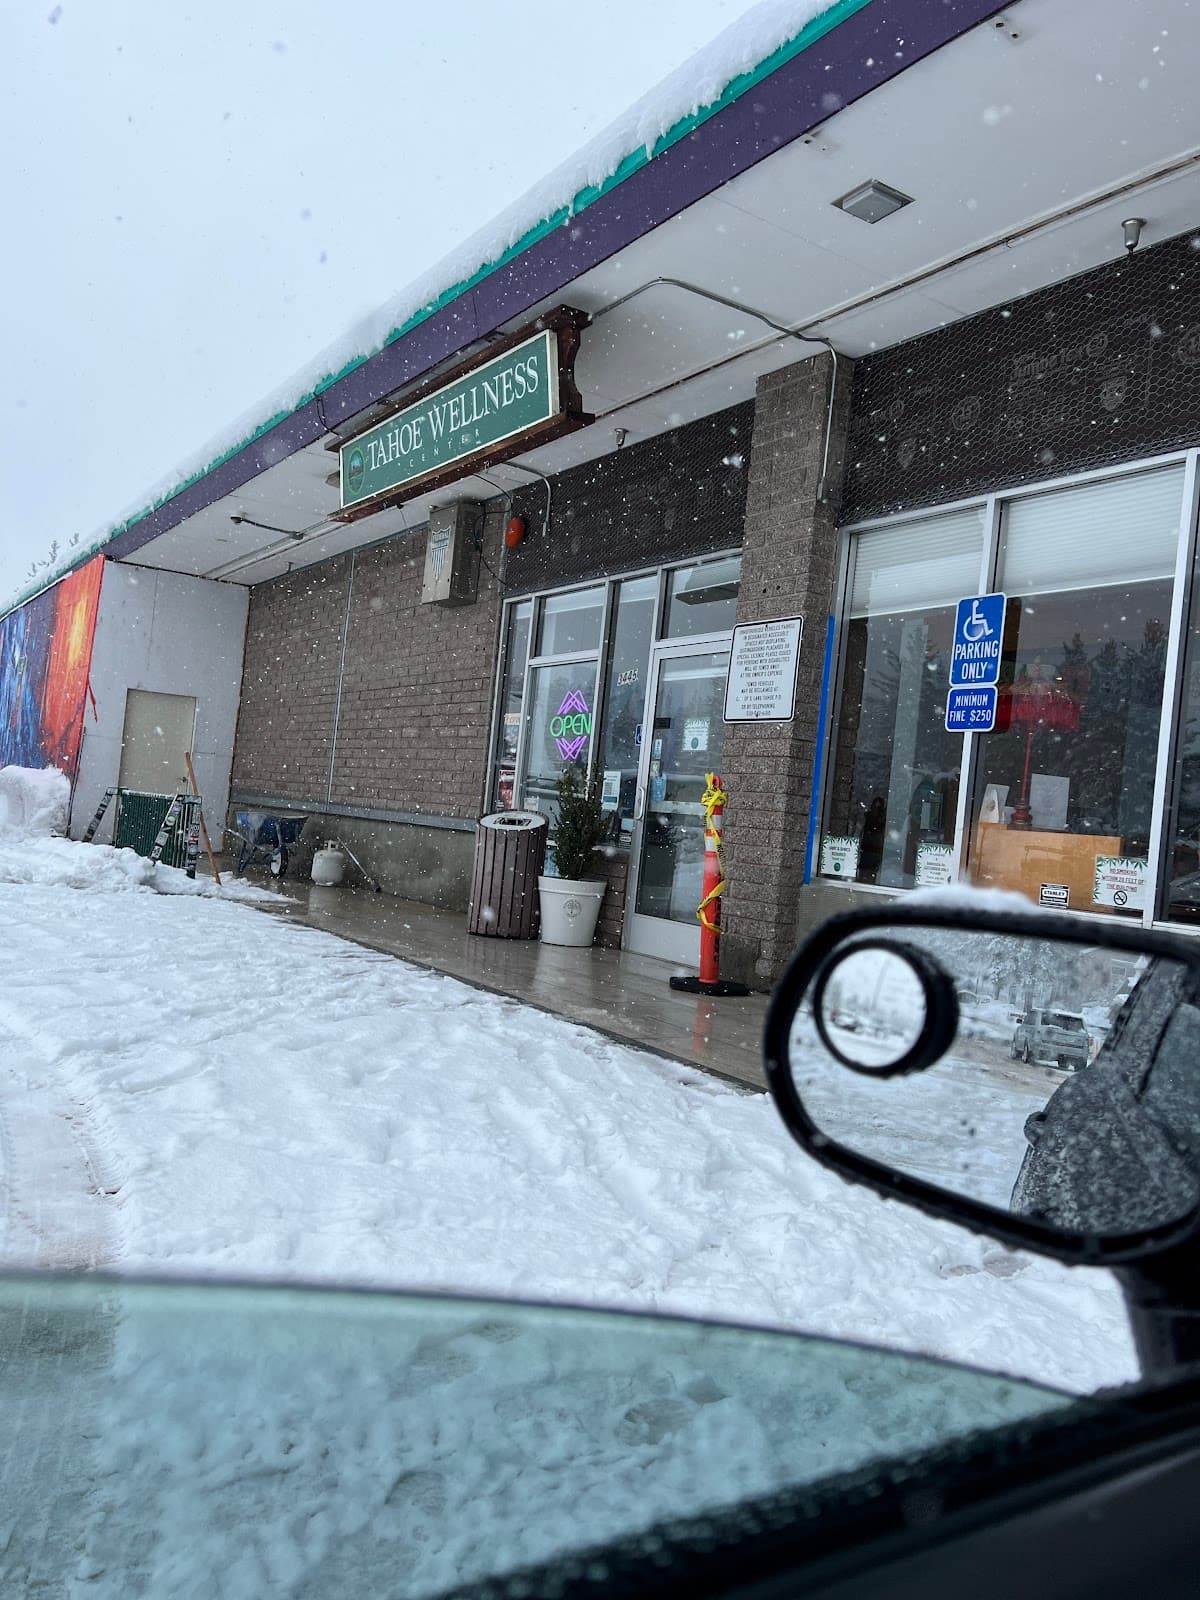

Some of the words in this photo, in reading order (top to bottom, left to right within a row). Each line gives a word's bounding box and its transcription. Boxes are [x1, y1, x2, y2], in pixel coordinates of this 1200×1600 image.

[367, 418, 423, 471] TAHOE
[428, 356, 539, 441] WELLNESS
[409, 429, 480, 468] CENTER
[955, 640, 998, 660] PARKING
[961, 662, 988, 680] ONLY
[956, 694, 988, 707] MINIMUM
[550, 713, 592, 737] OPEN
[950, 710, 966, 722] FINE
[970, 710, 992, 722] $250
